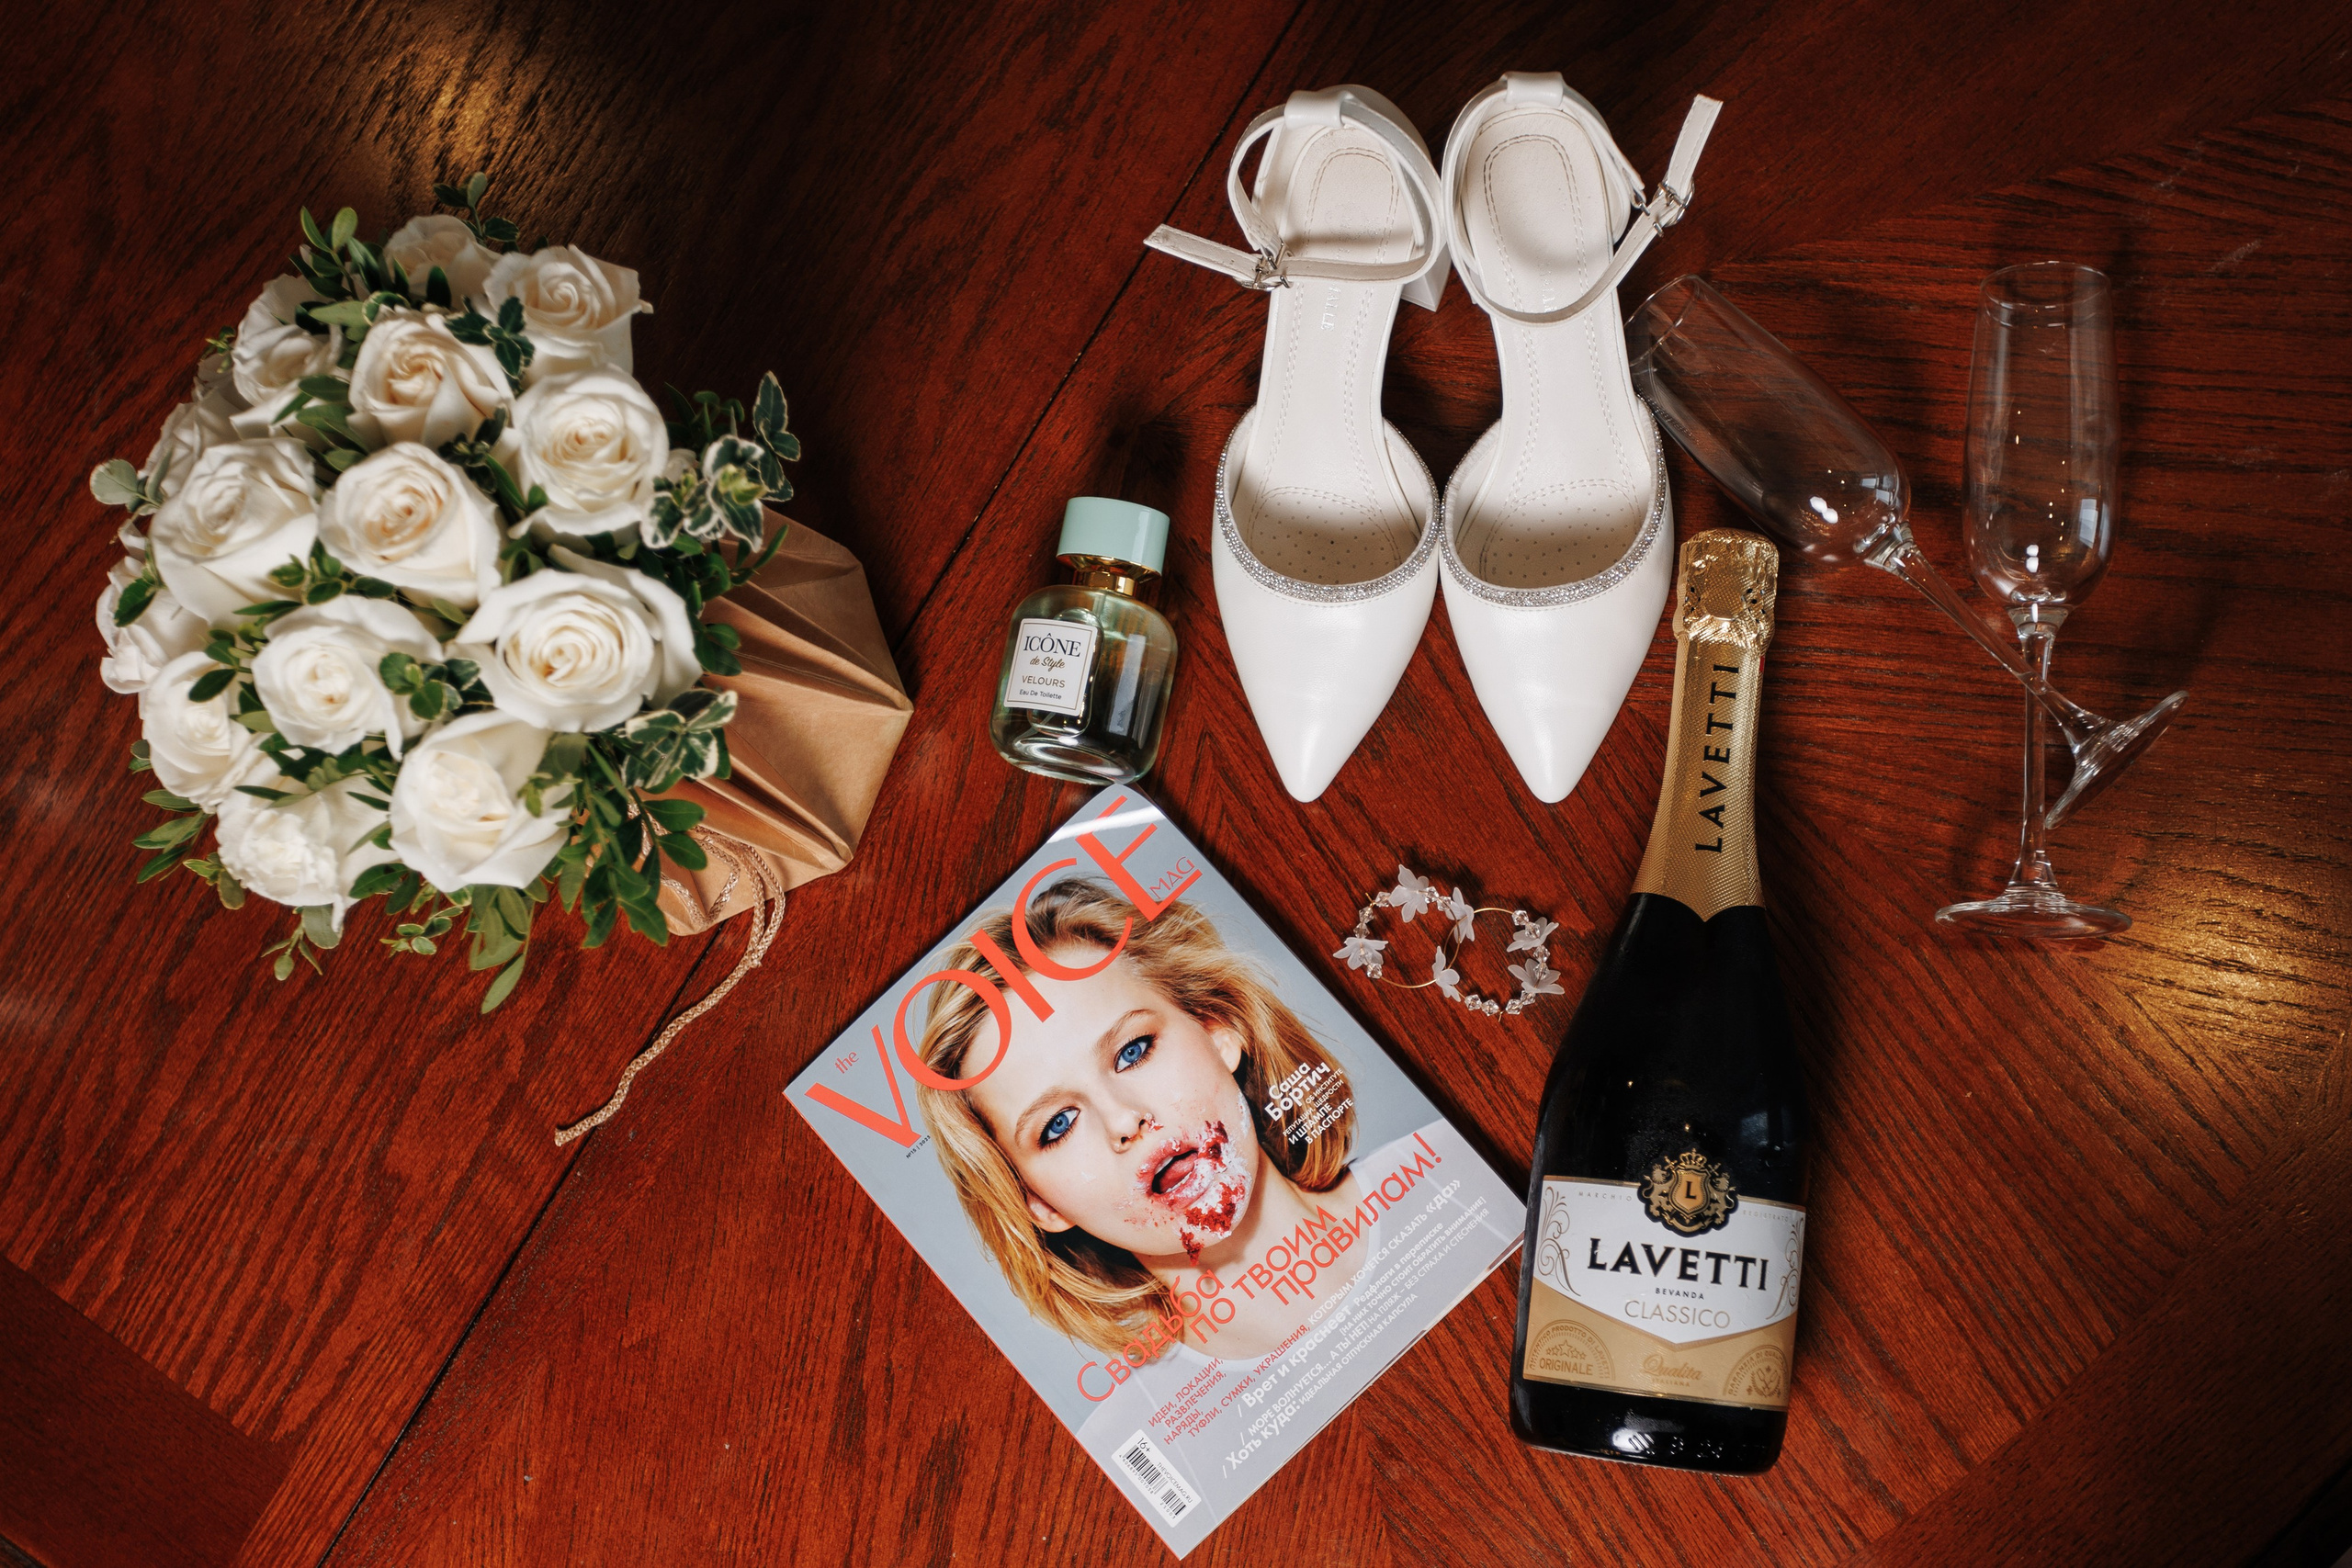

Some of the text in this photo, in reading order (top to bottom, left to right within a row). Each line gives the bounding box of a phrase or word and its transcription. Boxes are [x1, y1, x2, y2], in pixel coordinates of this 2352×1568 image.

[1023, 633, 1080, 657] ICÔNE
[1030, 656, 1065, 671] de Style
[1022, 675, 1065, 688] VELOURS
[1040, 691, 1062, 699] Toilette
[1695, 663, 1739, 853] LAVETTI
[1148, 853, 1196, 900] MAG
[803, 793, 1203, 1148] VOICE
[831, 1046, 860, 1075] the
[1268, 1061, 1311, 1099] Саша
[1263, 1061, 1331, 1122] Бортич
[1304, 1066, 1344, 1105] ОБ ИНСТИТУТЕ
[1313, 1078, 1344, 1109] ЩЕДРОСТИ
[1288, 1101, 1333, 1145] И ШТАМПЕ
[1304, 1097, 1353, 1145] В ПАСПОРТЕ
[1578, 1190, 1633, 1202] MARCHIO
[1685, 1180, 1697, 1200] L
[1269, 1131, 1442, 1305] правилам!
[1186, 1201, 1338, 1345] по твоим
[1351, 1305, 1369, 1323] НИХ
[1366, 1283, 1393, 1309] ТОЧНО
[1389, 1263, 1414, 1287] СТОИТ
[1410, 1233, 1446, 1267] ОБРАТИТЬ
[1588, 1237, 1769, 1291] LAVETTI
[1187, 1180, 1459, 1438] ТУФЛИ, СУМКИ, УКРАШЕНИЯ, КОТОРЫМ ХОЧЕТСЯ СКАЗАТЬ «да»
[1240, 1373, 1280, 1408] Врет
[1276, 1363, 1291, 1378] и
[1288, 1304, 1353, 1367] краснеет
[1352, 1267, 1396, 1307] Редфлаги
[1393, 1261, 1401, 1270] в
[1398, 1222, 1444, 1265] переписке
[1624, 1300, 1730, 1328] CLASSICO
[1655, 1288, 1704, 1300] BEVANDA
[1075, 1267, 1226, 1403] Свадьба
[1246, 1408, 1275, 1436] МОРЕ
[1328, 1348, 1340, 1360] А
[1335, 1337, 1351, 1353] ТЫ
[1348, 1319, 1370, 1341] НЕТ!
[1366, 1310, 1381, 1325] НА
[1376, 1291, 1401, 1314] ПЛЯЖ
[1403, 1273, 1419, 1290] БЕЗ
[1416, 1249, 1446, 1278] СТРАХА
[1442, 1243, 1452, 1254] И
[1447, 1207, 1490, 1247] СТЕСНЕНИЯ
[1225, 1435, 1263, 1471] Хоть
[1260, 1399, 1301, 1439] куда:
[1297, 1361, 1344, 1406] ИДЕАЛЬНАЯ
[1340, 1323, 1385, 1366] ОТПУСКНАЯ
[1381, 1291, 1419, 1327] КАПСУЛА
[1539, 1358, 1594, 1376] ORIGINALE
[1147, 1355, 1223, 1427] ИДЕИ, ЛОКАЦИИ,
[1163, 1368, 1227, 1427] РАЗВЛЕЧЕНИЯ,
[1136, 1436, 1153, 1455] 16+
[1162, 1406, 1204, 1445] НАРЯДЫ,
